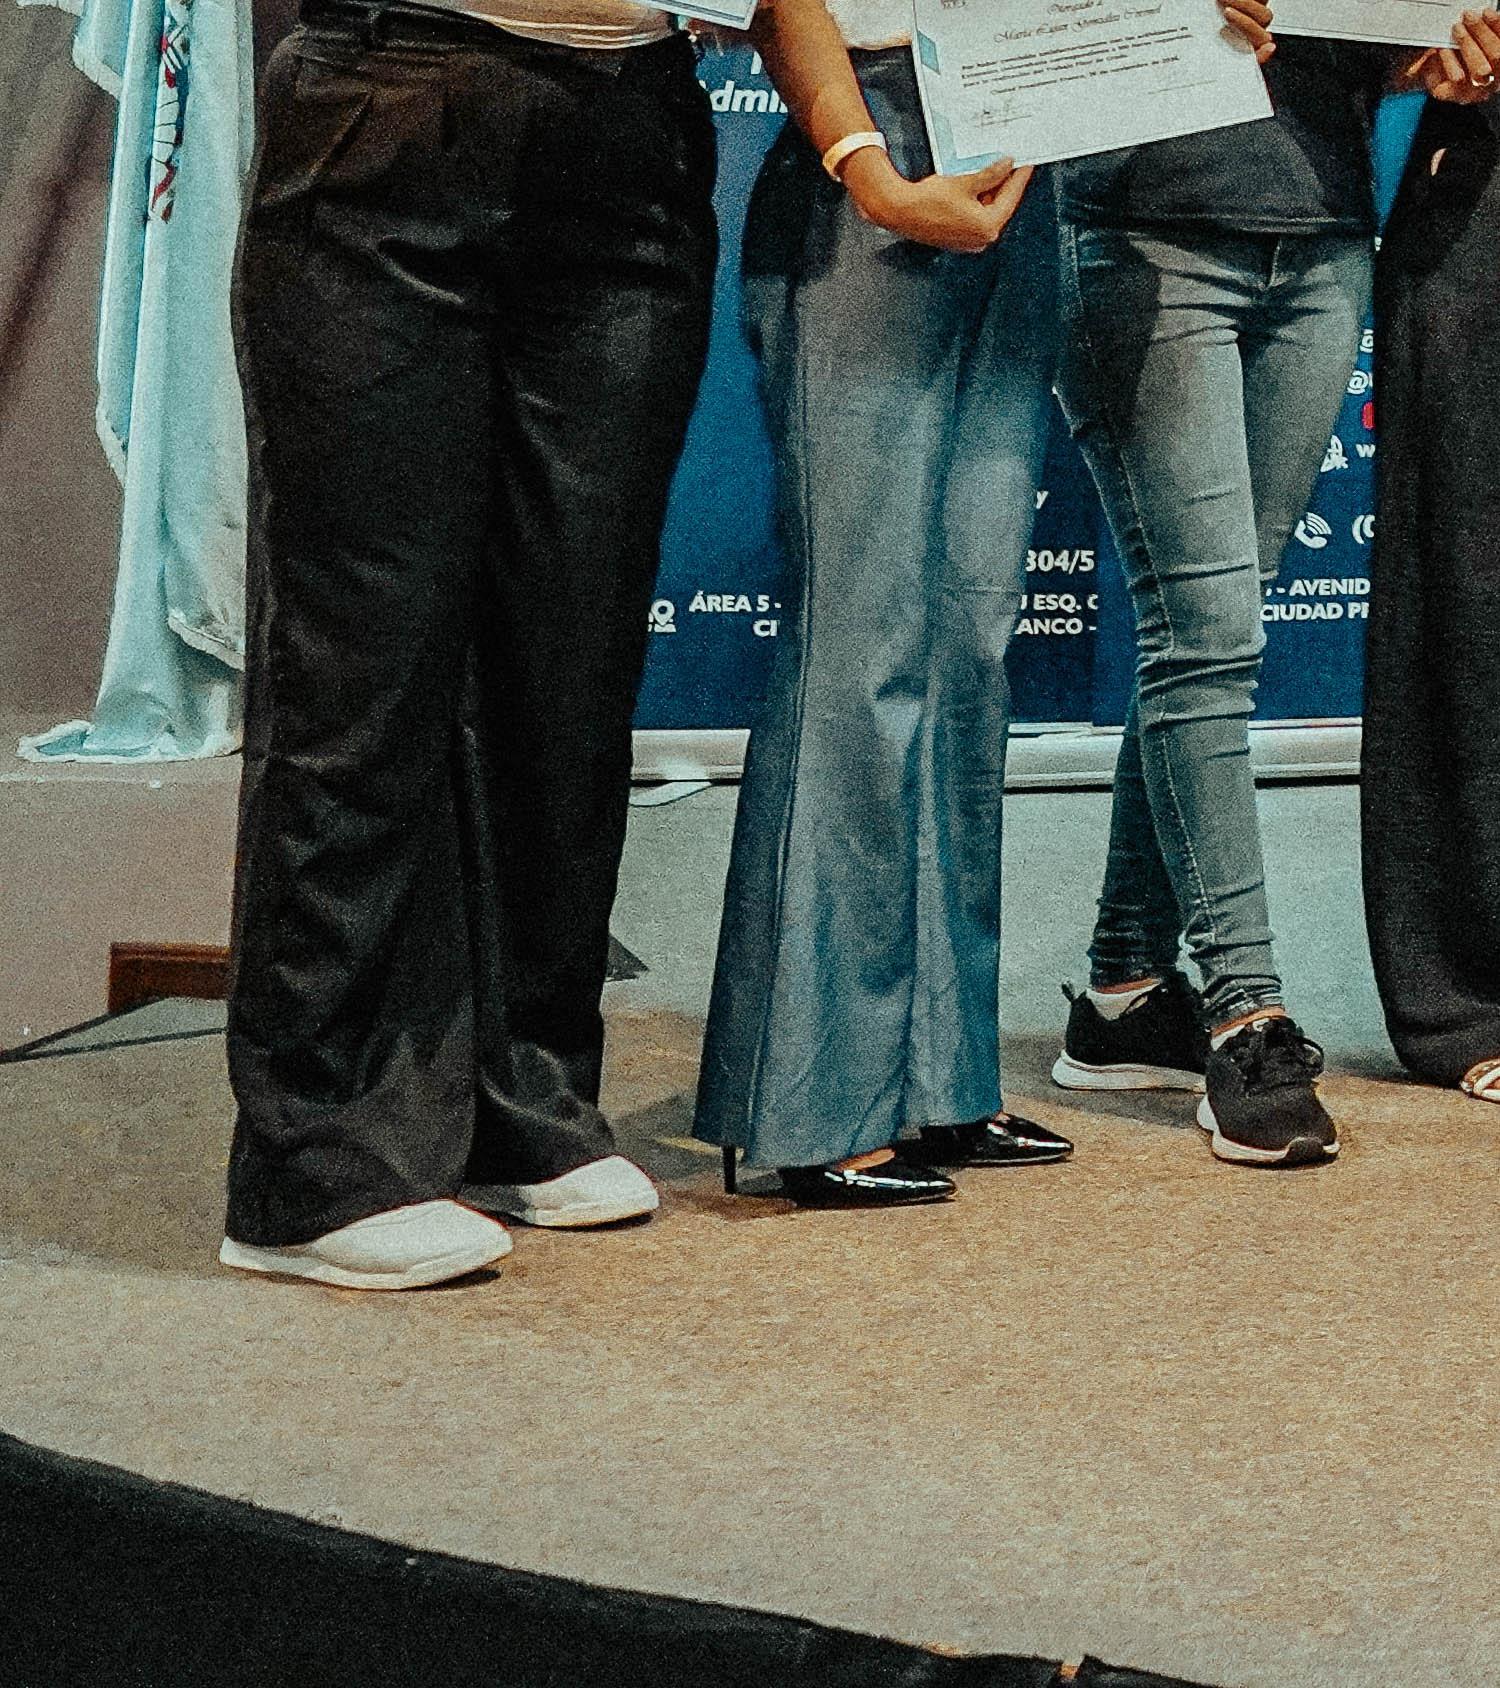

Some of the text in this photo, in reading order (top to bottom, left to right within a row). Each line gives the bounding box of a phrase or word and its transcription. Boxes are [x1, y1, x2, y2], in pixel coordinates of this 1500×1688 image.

[688, 590, 752, 612] ÁREA
[756, 594, 770, 612] 5
[1033, 593, 1082, 613] ESQ.
[1259, 602, 1344, 622] CIUDAD
